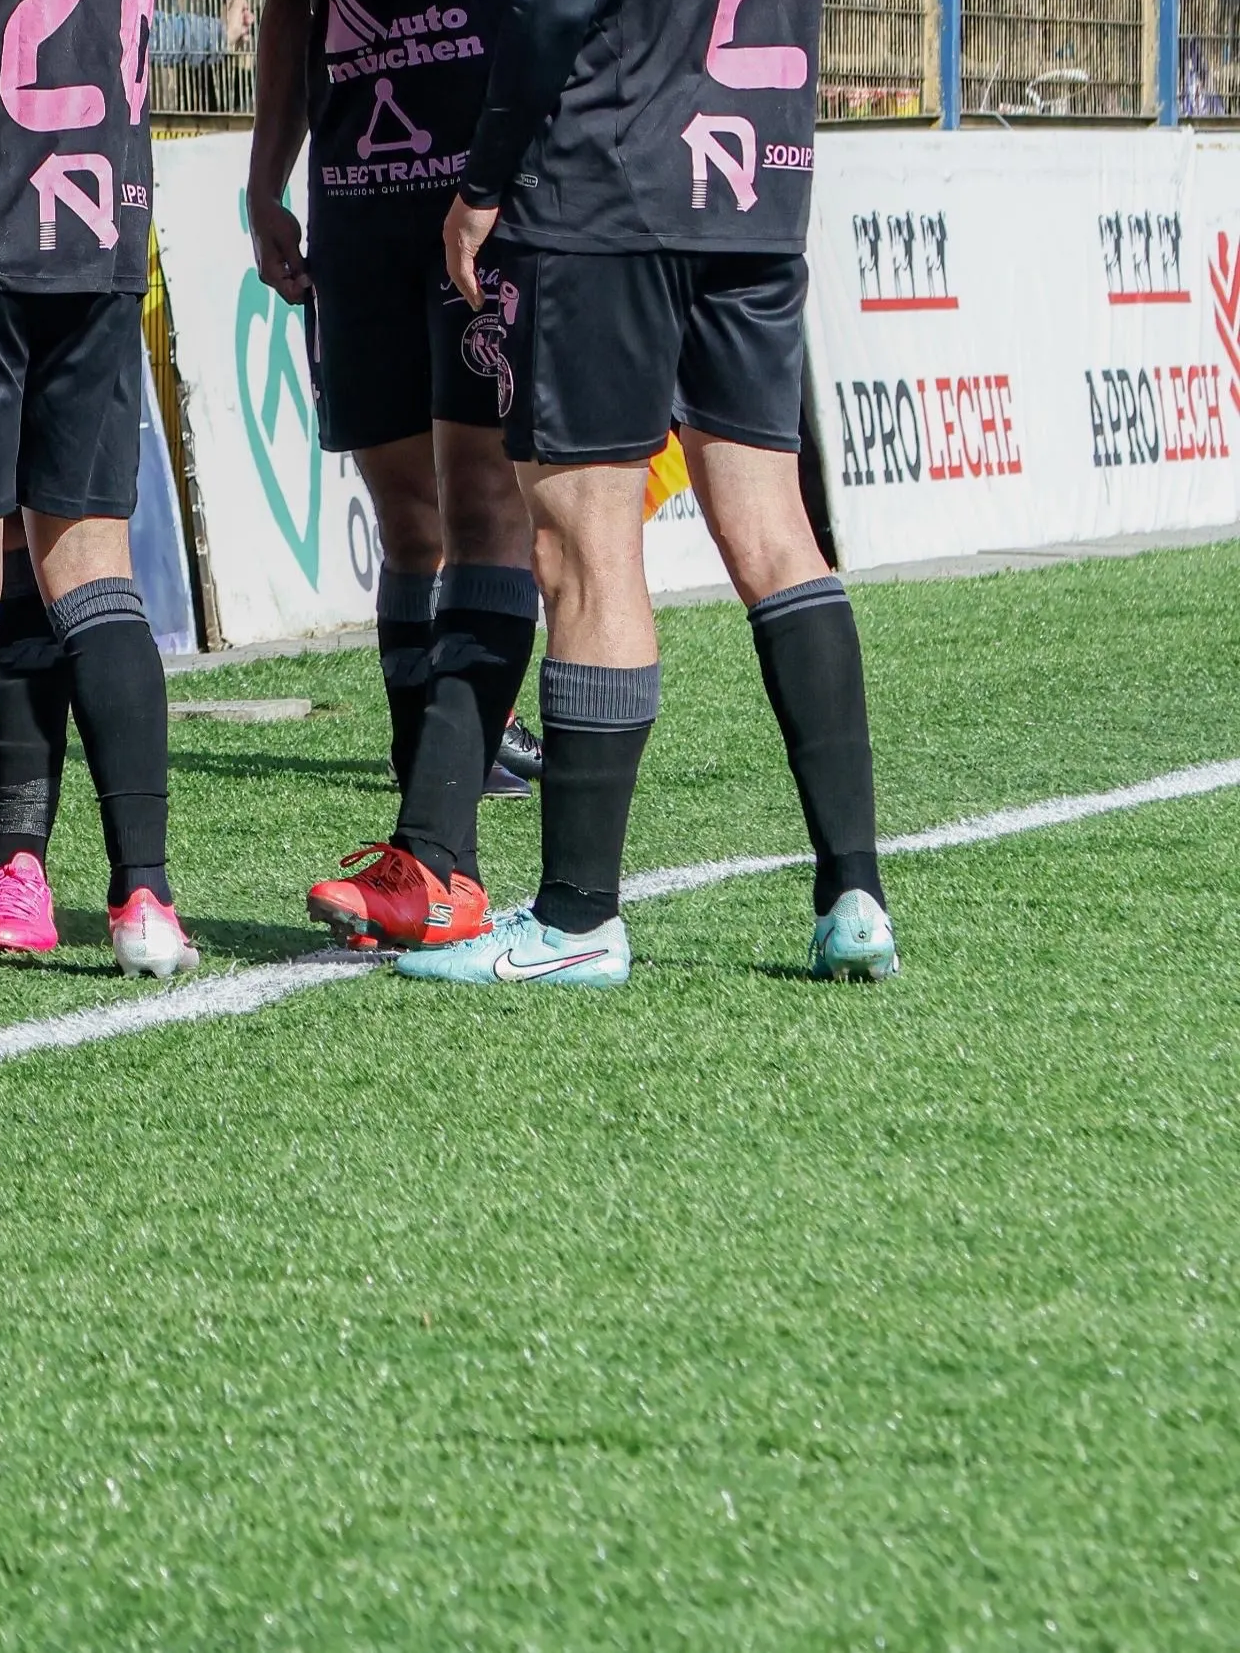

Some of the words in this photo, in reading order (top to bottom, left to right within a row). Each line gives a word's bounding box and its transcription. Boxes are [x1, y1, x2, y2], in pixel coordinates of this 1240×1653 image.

[322, 150, 471, 185] ELECTRANE
[764, 144, 814, 167] SODIP
[420, 177, 462, 190] RESGUA
[471, 318, 499, 331] SANTIAG
[835, 375, 1022, 487] APROLECHE
[1085, 365, 1230, 468] APROLECH
